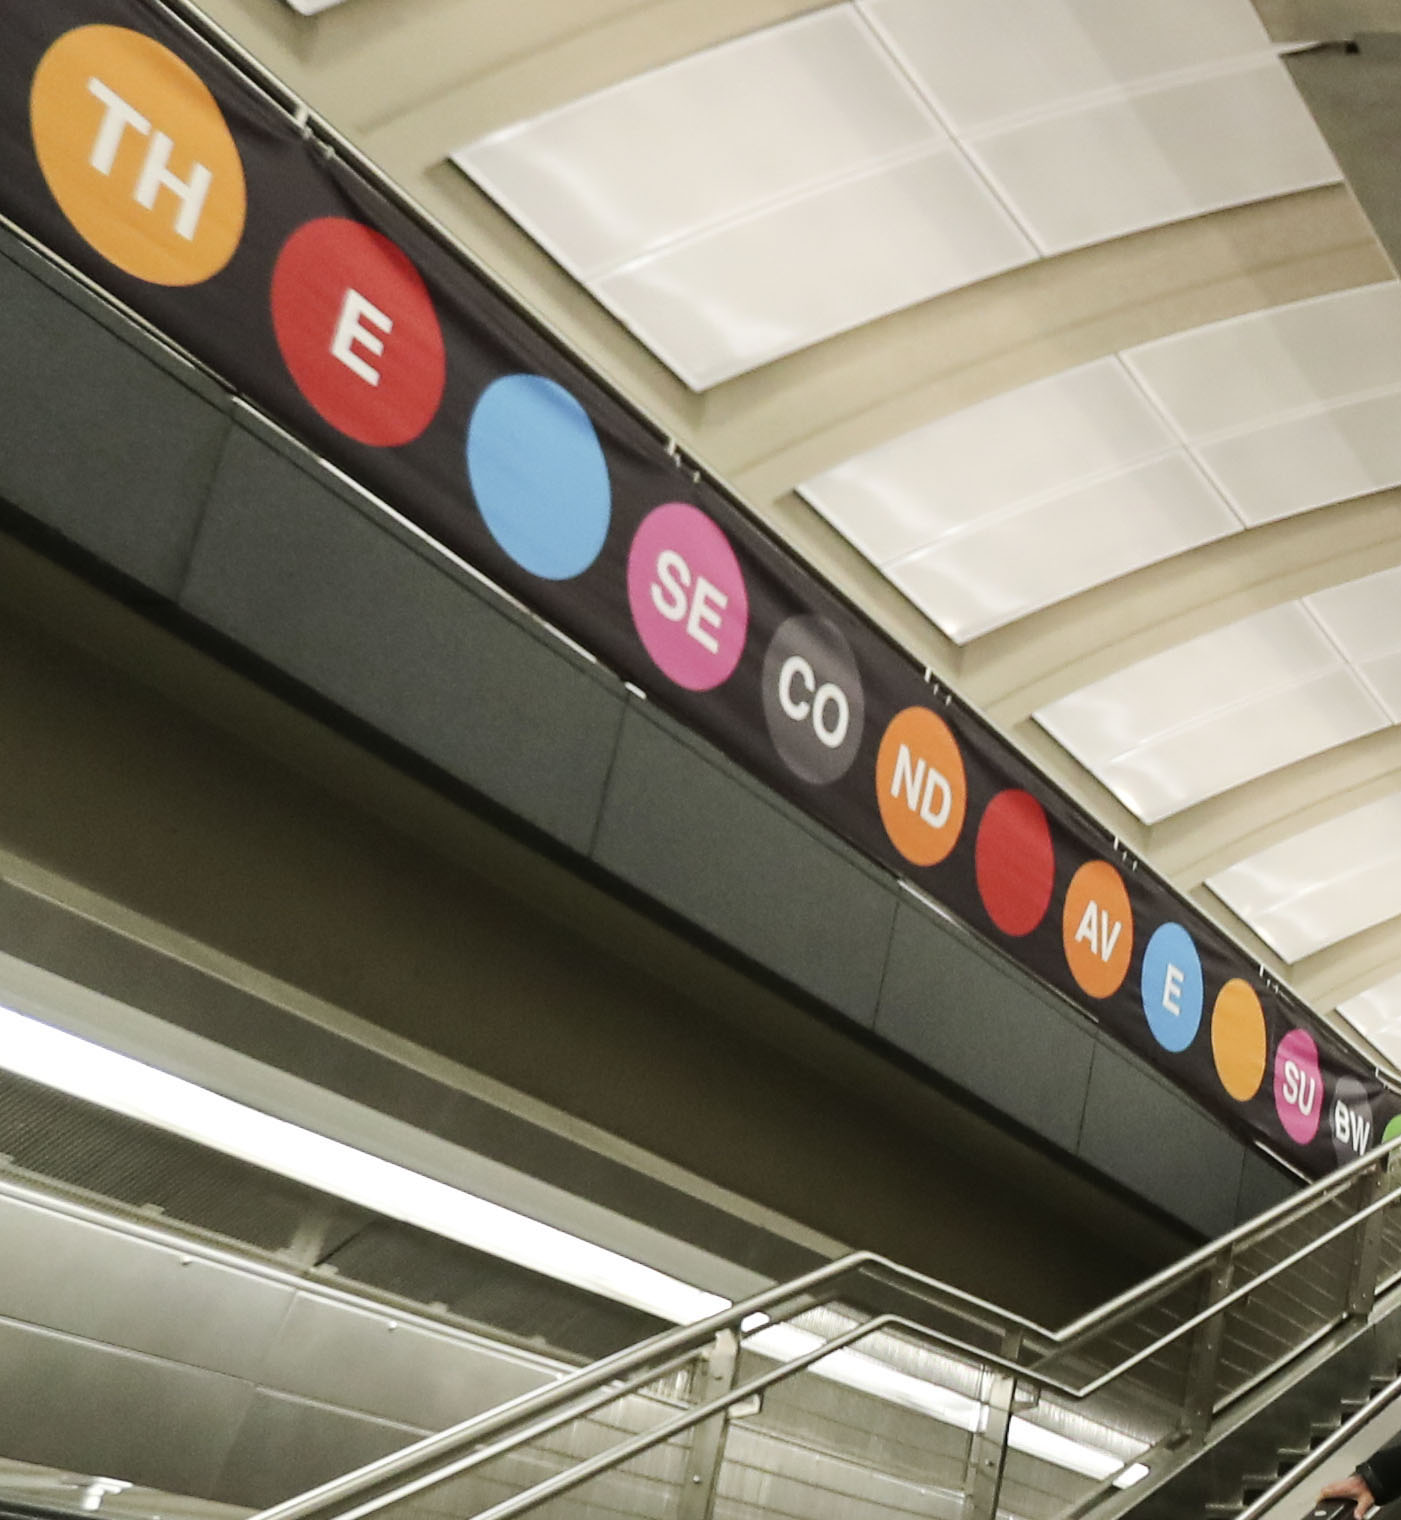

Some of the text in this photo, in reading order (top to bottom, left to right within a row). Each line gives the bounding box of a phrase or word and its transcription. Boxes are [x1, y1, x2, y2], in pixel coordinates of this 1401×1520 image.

[87, 77, 1370, 1157] TH E SE CO ND AV E SU BW
